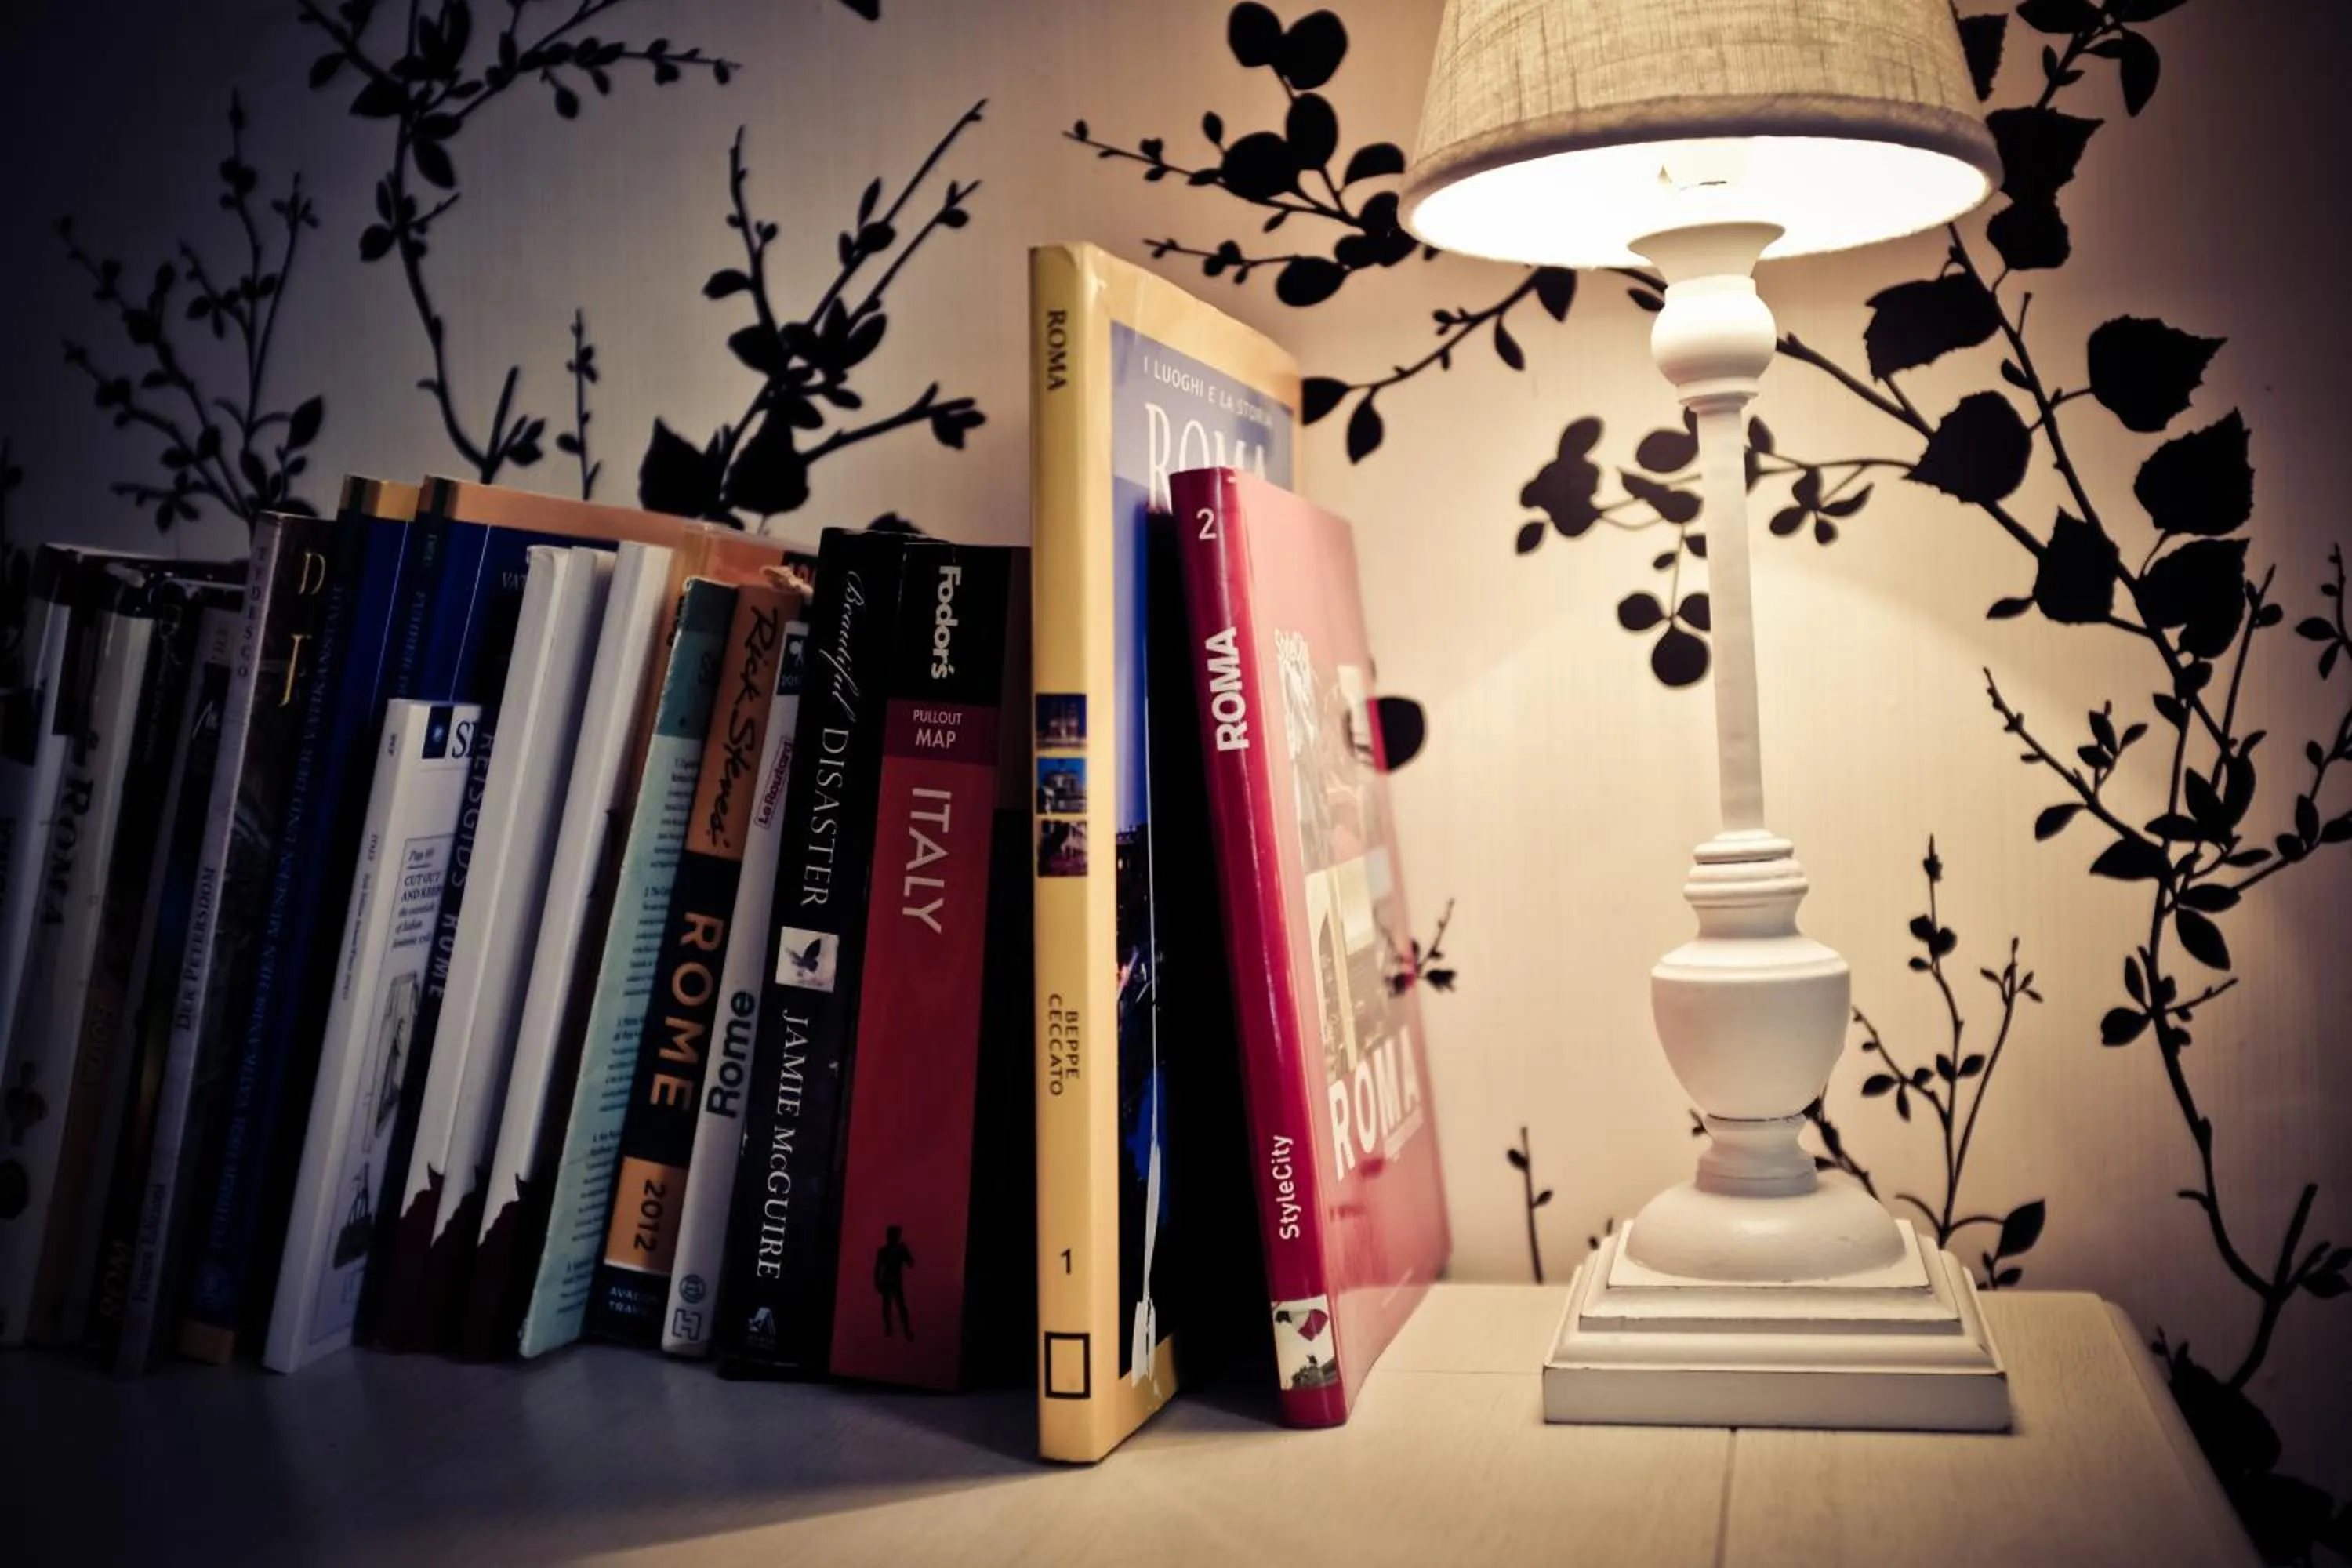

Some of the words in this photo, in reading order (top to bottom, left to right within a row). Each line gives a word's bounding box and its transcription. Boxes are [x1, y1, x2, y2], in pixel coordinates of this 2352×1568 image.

[1046, 309, 1068, 392] ROMA
[1154, 360, 1204, 397] LUOGHI
[1208, 386, 1216, 402] E
[1196, 508, 1218, 541] 2
[734, 605, 779, 707] Rick
[931, 565, 962, 679] Fodor's
[913, 709, 963, 726] PULLOUT
[914, 730, 956, 750] MAP
[1205, 627, 1250, 752] ROMA
[801, 728, 849, 906] DISASTER
[902, 788, 952, 935] ITALY
[650, 910, 724, 1112] ROME
[706, 991, 755, 1119] Rome
[1047, 993, 1063, 1096] CECCATO
[1065, 1010, 1080, 1080] BEPPE
[775, 1008, 809, 1117] JAMIE
[633, 1178, 666, 1252] 2012
[1272, 1134, 1300, 1240] StyleCity
[1060, 1249, 1072, 1274] 1
